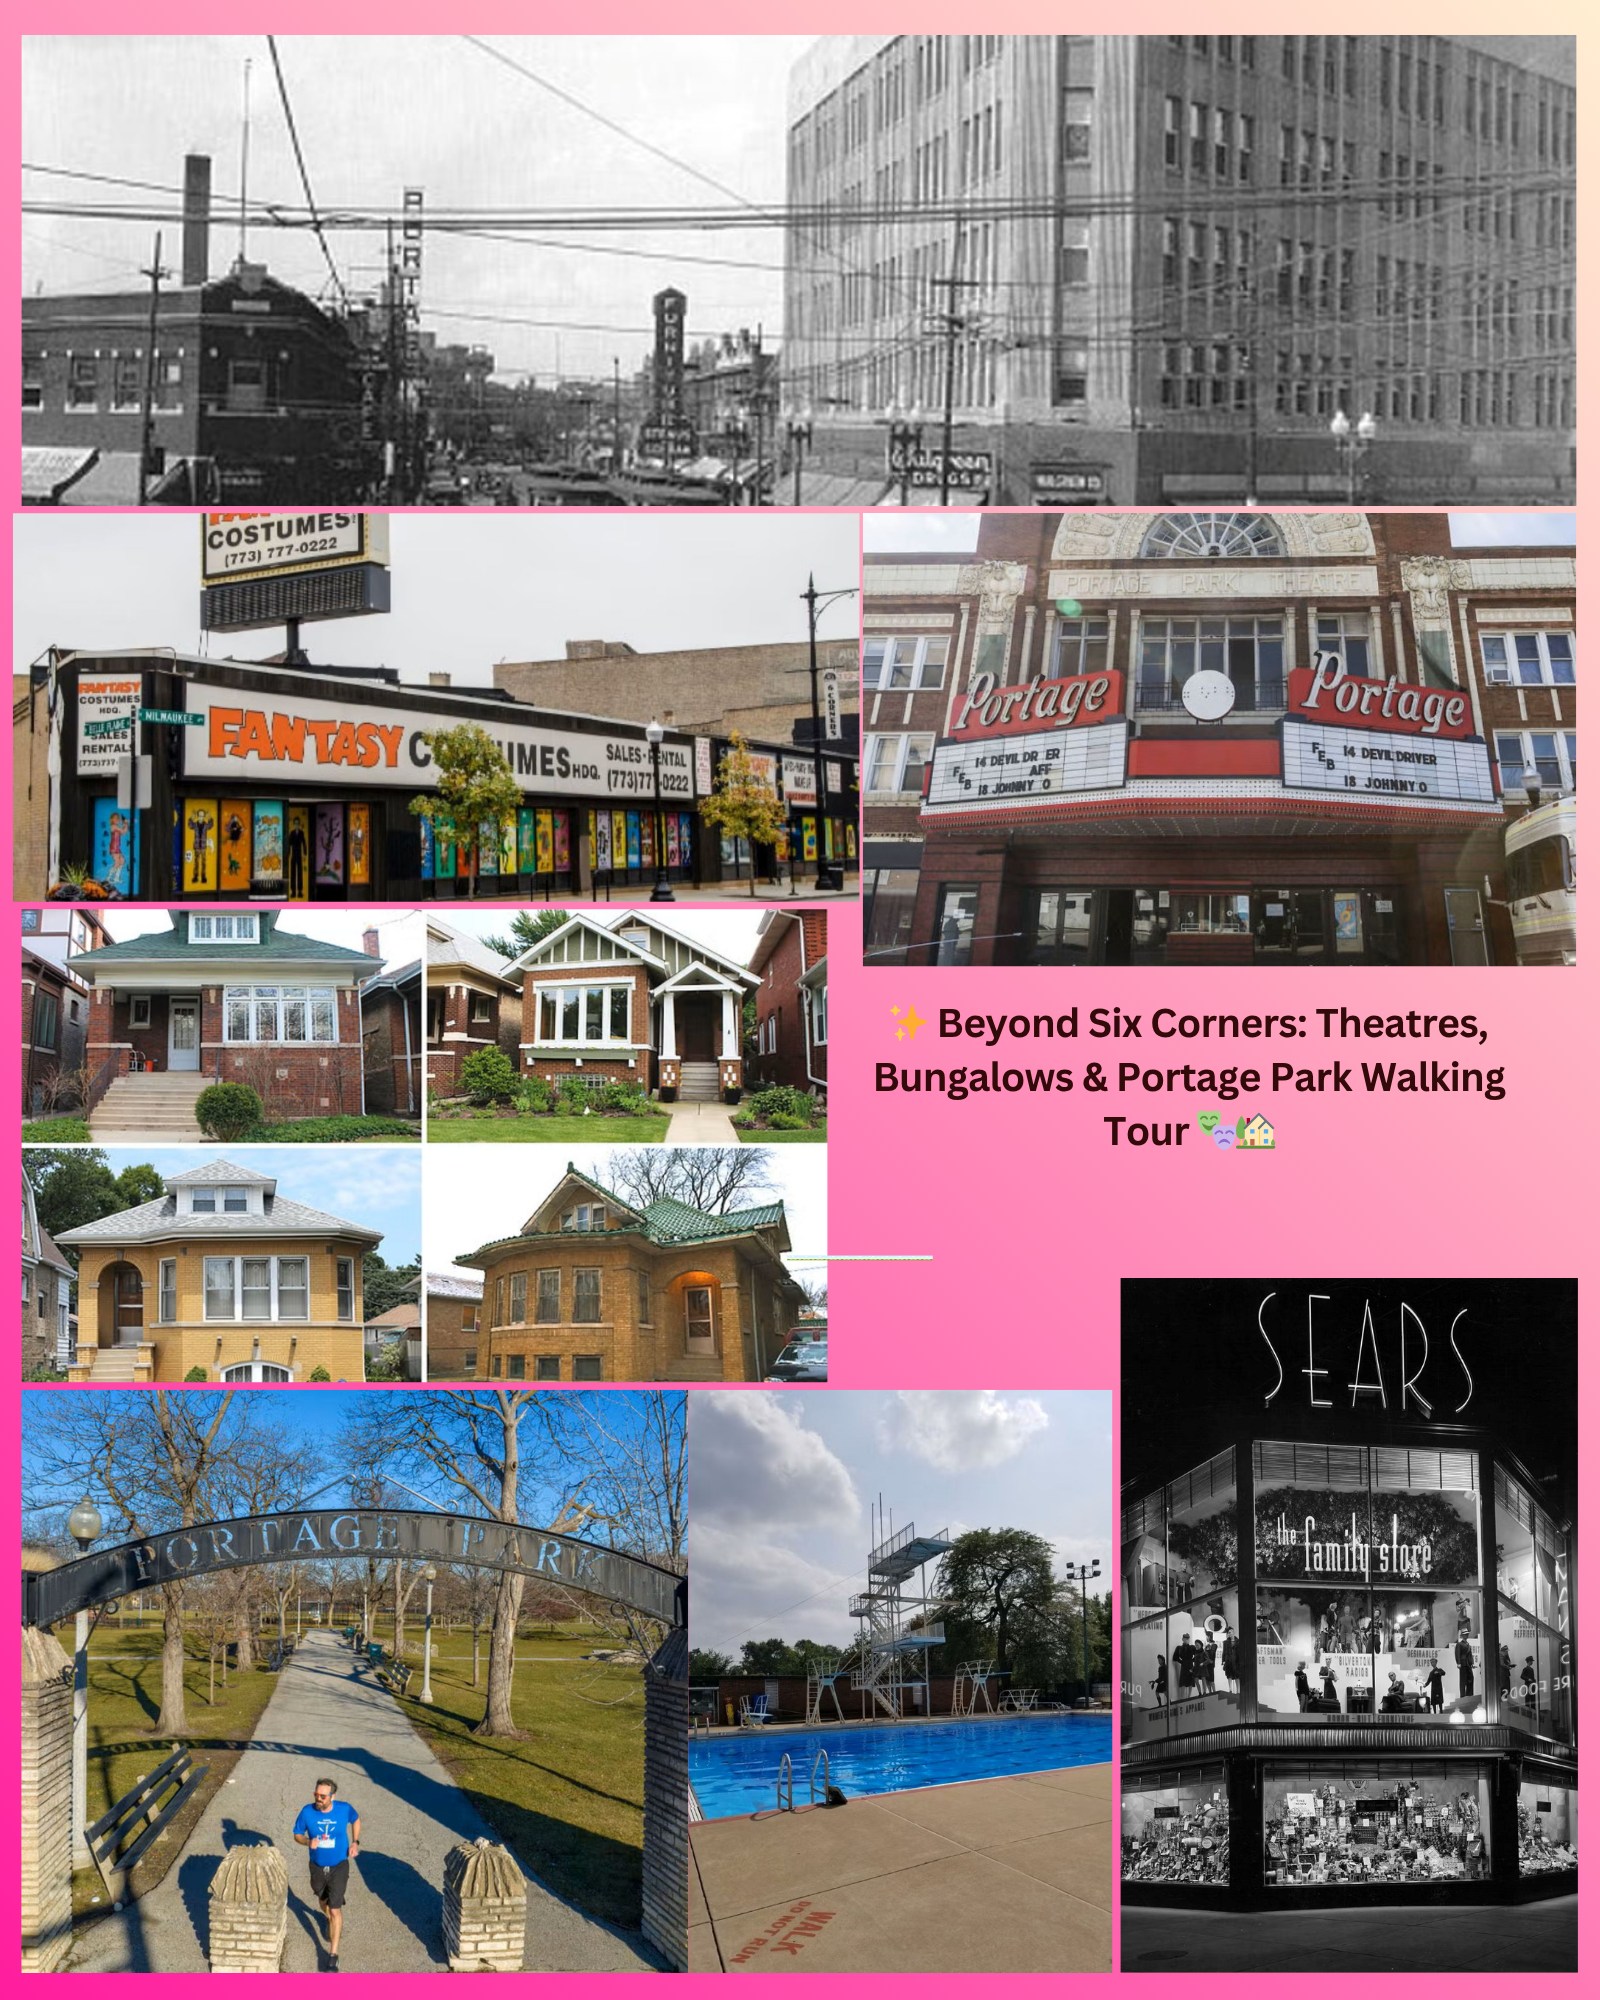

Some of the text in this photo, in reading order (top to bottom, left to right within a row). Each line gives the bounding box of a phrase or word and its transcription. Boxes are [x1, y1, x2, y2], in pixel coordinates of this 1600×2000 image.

[207, 513, 351, 549] COSTUMES
[225, 537, 338, 568] (773) 777-0222
[1065, 571, 1362, 595] PORTAGE PARK THEATRE
[78, 681, 142, 694] FANTASY
[79, 695, 141, 705] COSTUMES
[951, 671, 1110, 731] Portage
[1301, 650, 1466, 734] Portage
[207, 705, 405, 768] FANTASY
[572, 763, 601, 779] HDQ.
[1343, 745, 1356, 758] 14
[1029, 763, 1053, 776] AFF
[1344, 775, 1428, 793] 18 JOHNNY O
[978, 784, 989, 796] 18
[992, 779, 1034, 794] JOHNNY
[1257, 1291, 1474, 1414] SEARS
[1277, 1512, 1297, 1546] the
[134, 1514, 606, 1586] PORTAGE PARK
[1304, 1512, 1432, 1583] family store
[1269, 1656, 1287, 1665] TOOLS
[1346, 1667, 1369, 1677] RADIOS
[729, 1901, 812, 1964] DO NOT RUN
[770, 1911, 837, 1955] WALK
